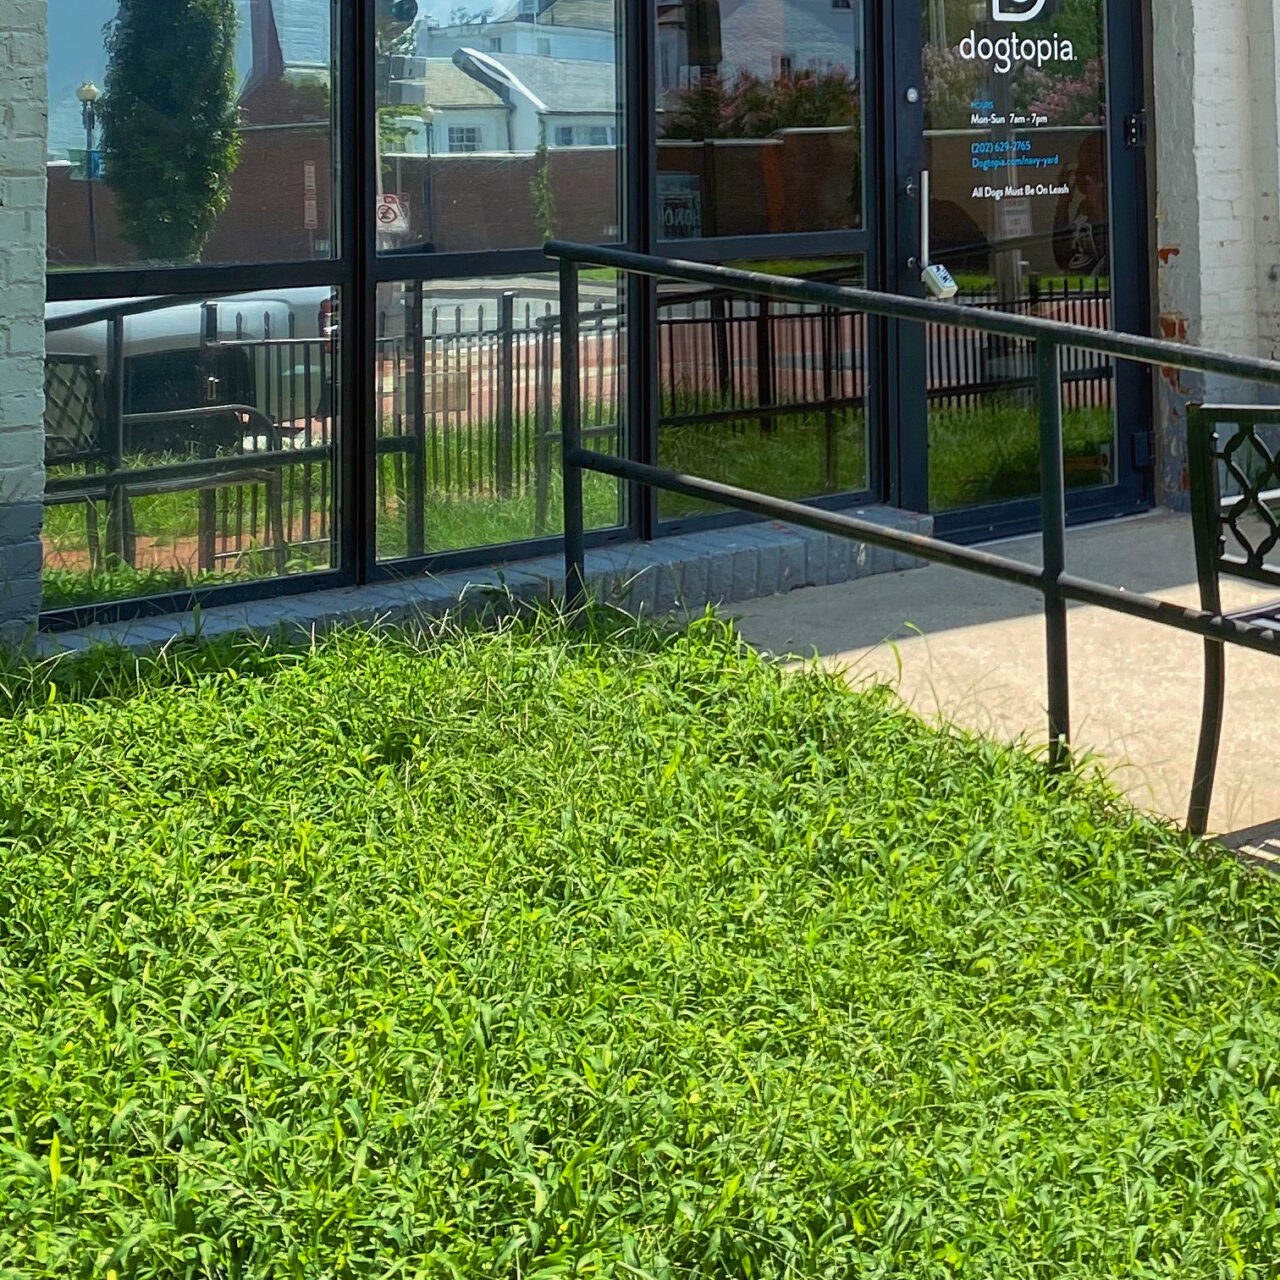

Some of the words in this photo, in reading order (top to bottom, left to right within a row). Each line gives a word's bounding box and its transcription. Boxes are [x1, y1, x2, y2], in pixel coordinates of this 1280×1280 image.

[970, 101, 994, 109] HOURS
[970, 113, 1005, 125] Mon-Sun
[971, 142, 993, 154] (202)
[972, 186, 983, 198] All
[984, 186, 1004, 200] Dogs
[1004, 186, 1024, 197] Must
[1024, 184, 1035, 196] Be
[1035, 184, 1048, 195] On
[1049, 183, 1069, 195] Leash
